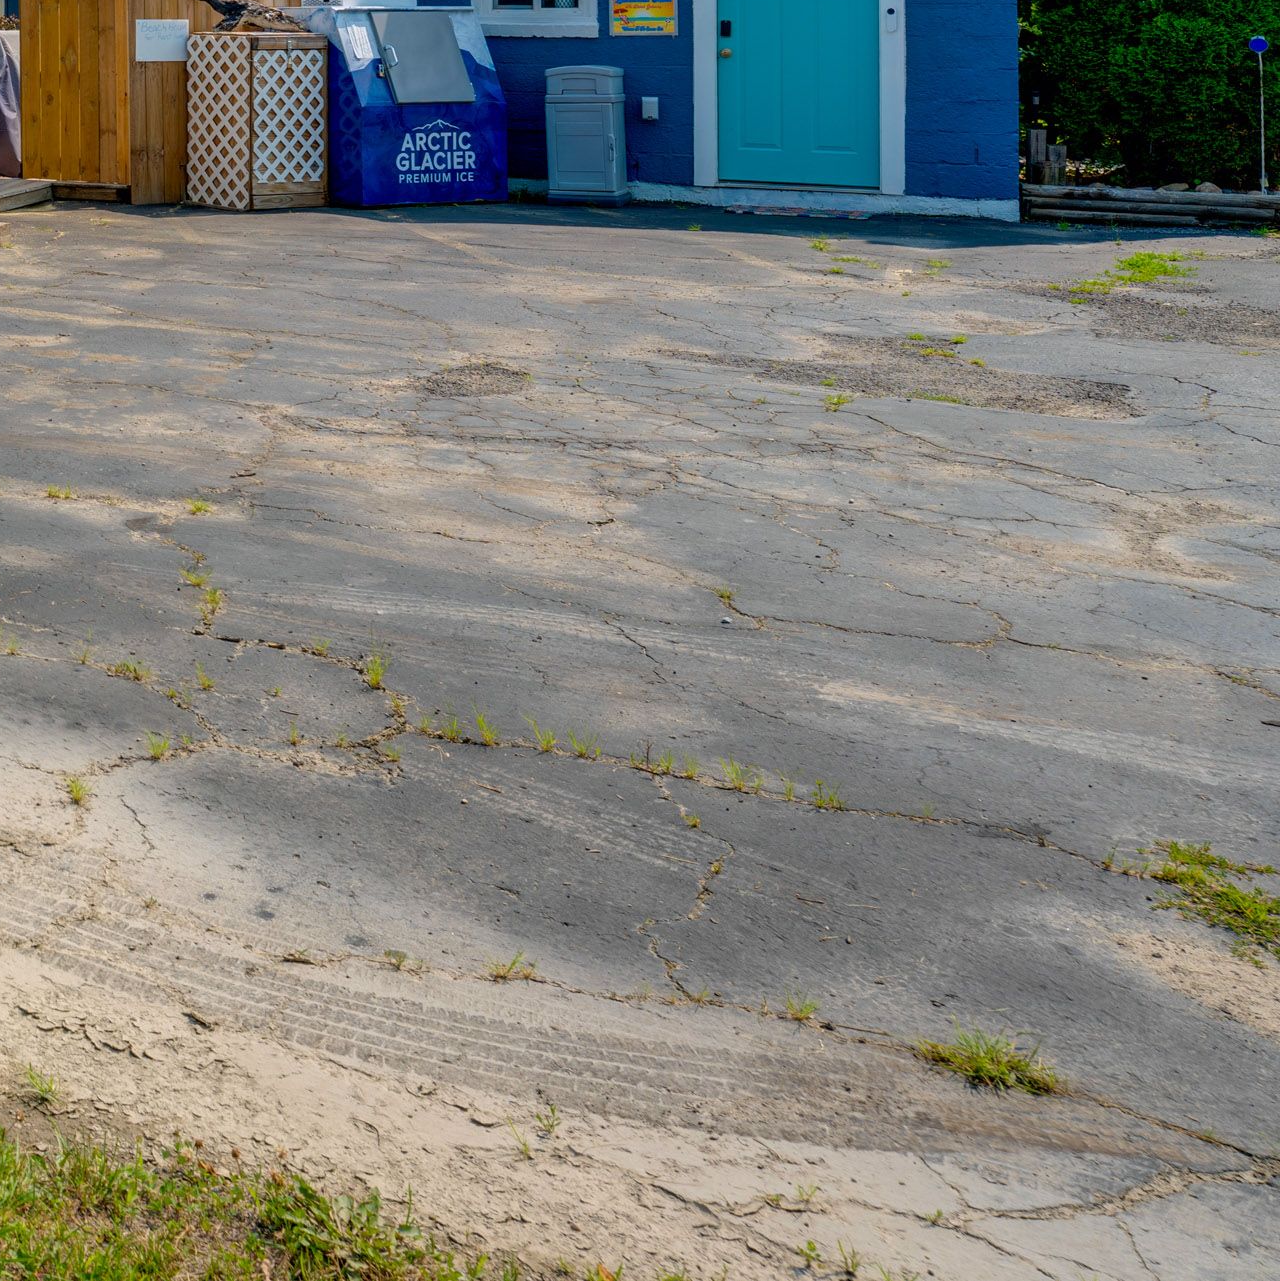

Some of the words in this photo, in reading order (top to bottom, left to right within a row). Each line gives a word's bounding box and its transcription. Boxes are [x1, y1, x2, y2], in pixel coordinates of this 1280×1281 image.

[401, 131, 471, 151] ARCTIC
[396, 151, 476, 171] GLACIER
[398, 172, 451, 184] PREMIUM
[456, 171, 474, 182] ICE
